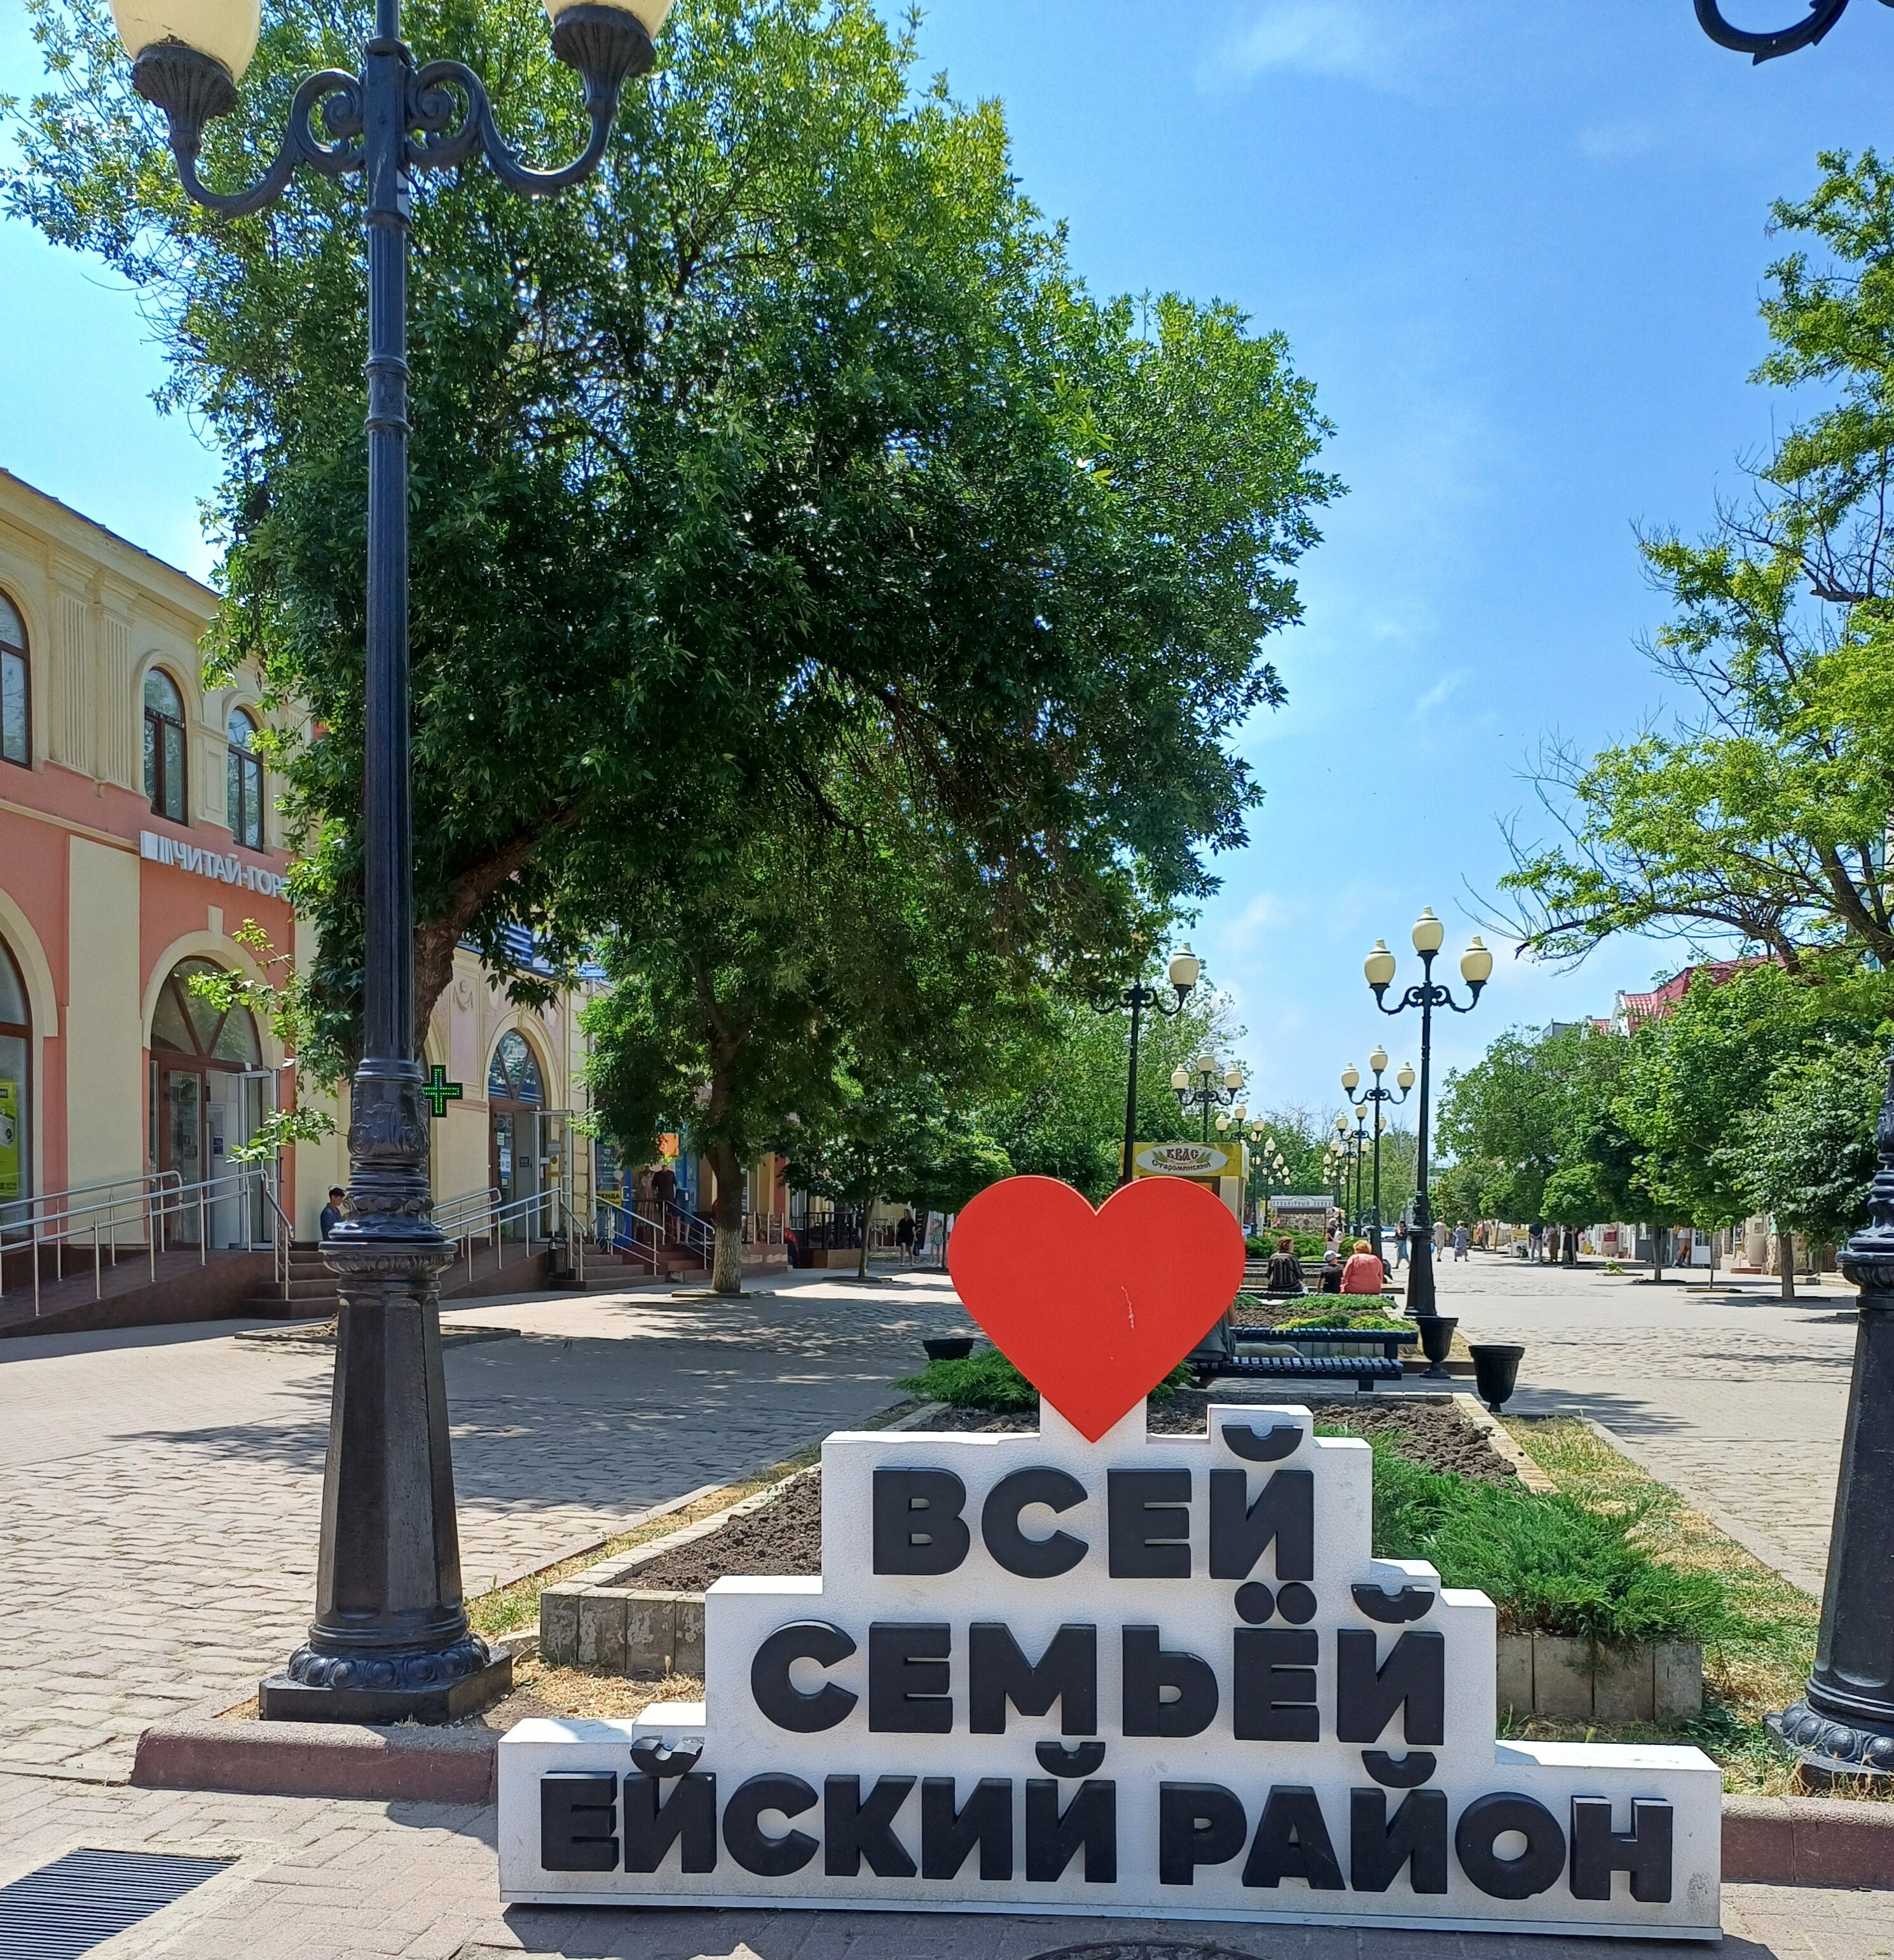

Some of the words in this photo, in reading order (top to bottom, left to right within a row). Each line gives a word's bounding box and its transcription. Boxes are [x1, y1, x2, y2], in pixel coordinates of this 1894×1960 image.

[1151, 1159, 1211, 1172] Староминский
[1166, 1147, 1199, 1161] КВАС
[873, 1424, 1314, 1581] ВСЕЙ
[750, 1581, 1445, 1745] СЕМЬЁЙ
[540, 1736, 1116, 1883] ЕЙСКИЙ
[1159, 1750, 1673, 1903] РАЙОН
